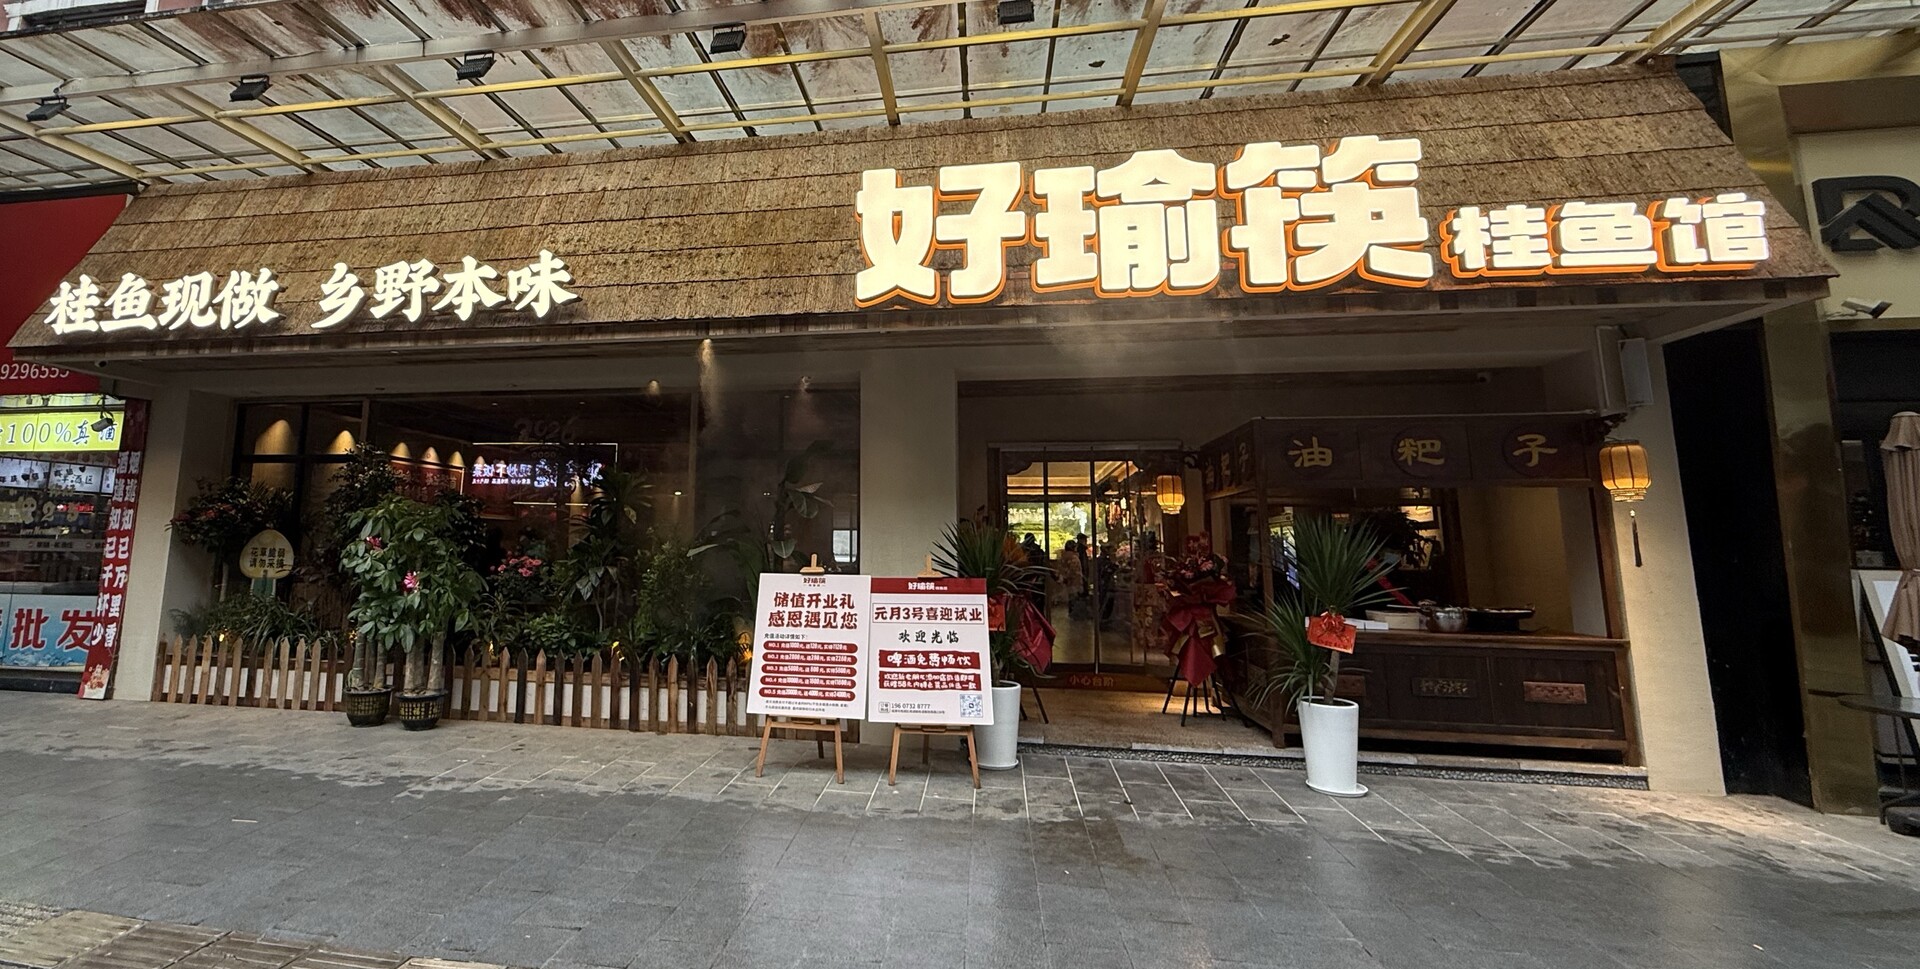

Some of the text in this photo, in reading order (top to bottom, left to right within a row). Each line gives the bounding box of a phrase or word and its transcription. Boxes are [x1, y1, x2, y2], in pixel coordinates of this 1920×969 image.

[855, 135, 1771, 302] 好瑜筷 桂鱼馆
[45, 250, 578, 335] 桂鱼现做 乡野本味
[1287, 433, 1559, 468] 油粑子
[773, 591, 855, 609] 储值开业礼
[767, 609, 858, 630] 感恩遇见您
[874, 606, 983, 622] 元月3号喜迎试业
[898, 629, 960, 644] 欢迎光临
[886, 651, 972, 667] 啤酒免费畅饮
[1068, 674, 1114, 688] 小心台阶
